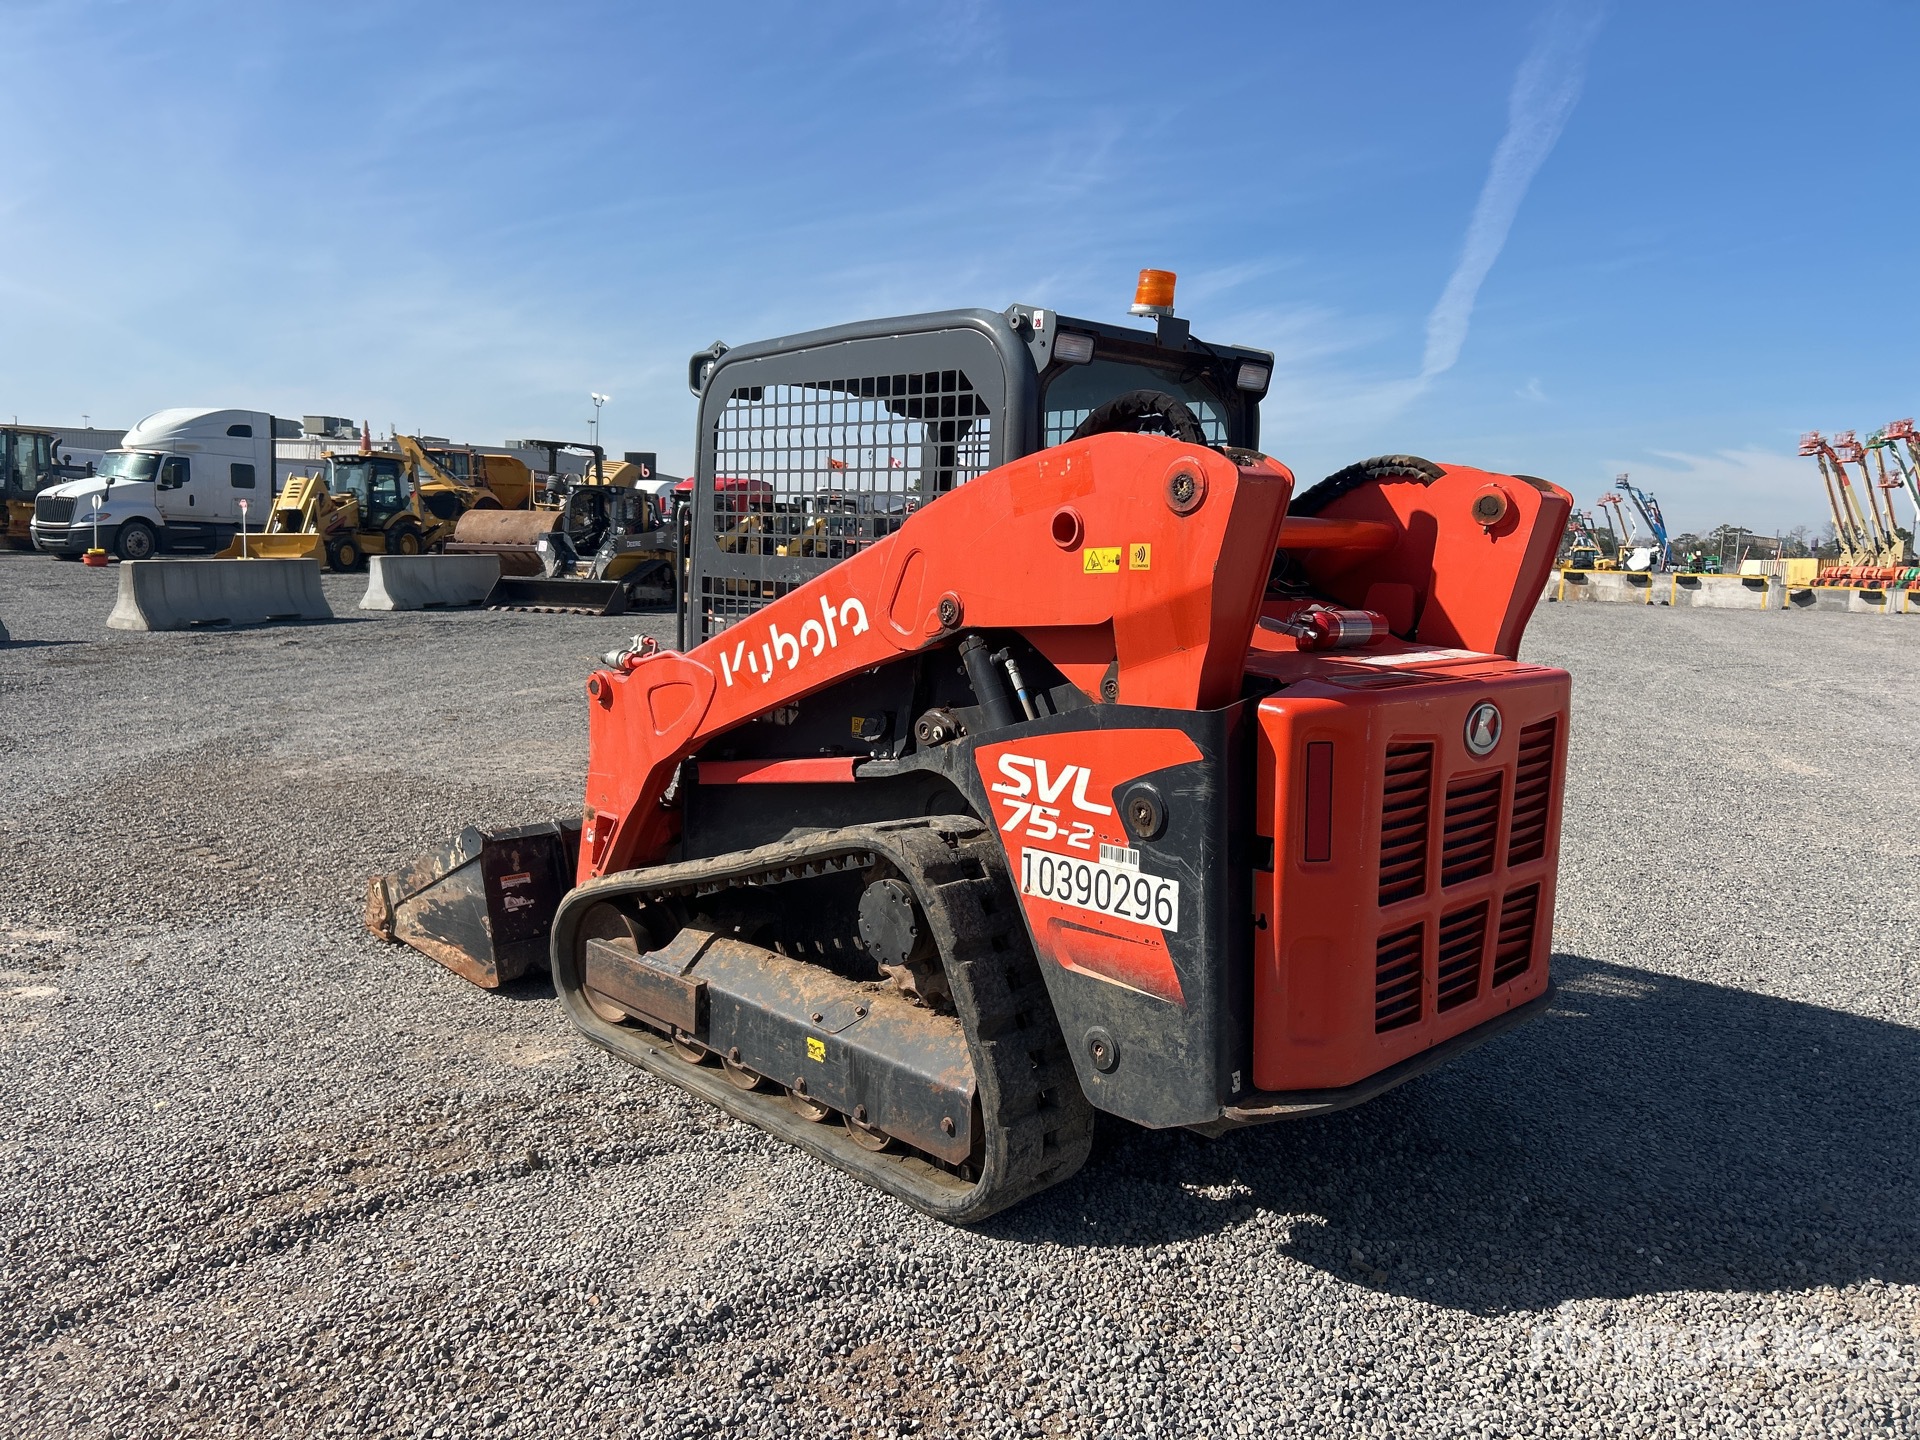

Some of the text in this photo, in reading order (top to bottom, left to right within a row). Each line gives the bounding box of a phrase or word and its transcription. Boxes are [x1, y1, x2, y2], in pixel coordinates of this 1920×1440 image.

[719, 595, 869, 687] Kubota
[991, 753, 1112, 816] SVL
[1001, 798, 1094, 850] 75-2
[1022, 853, 1173, 926] 10390296
